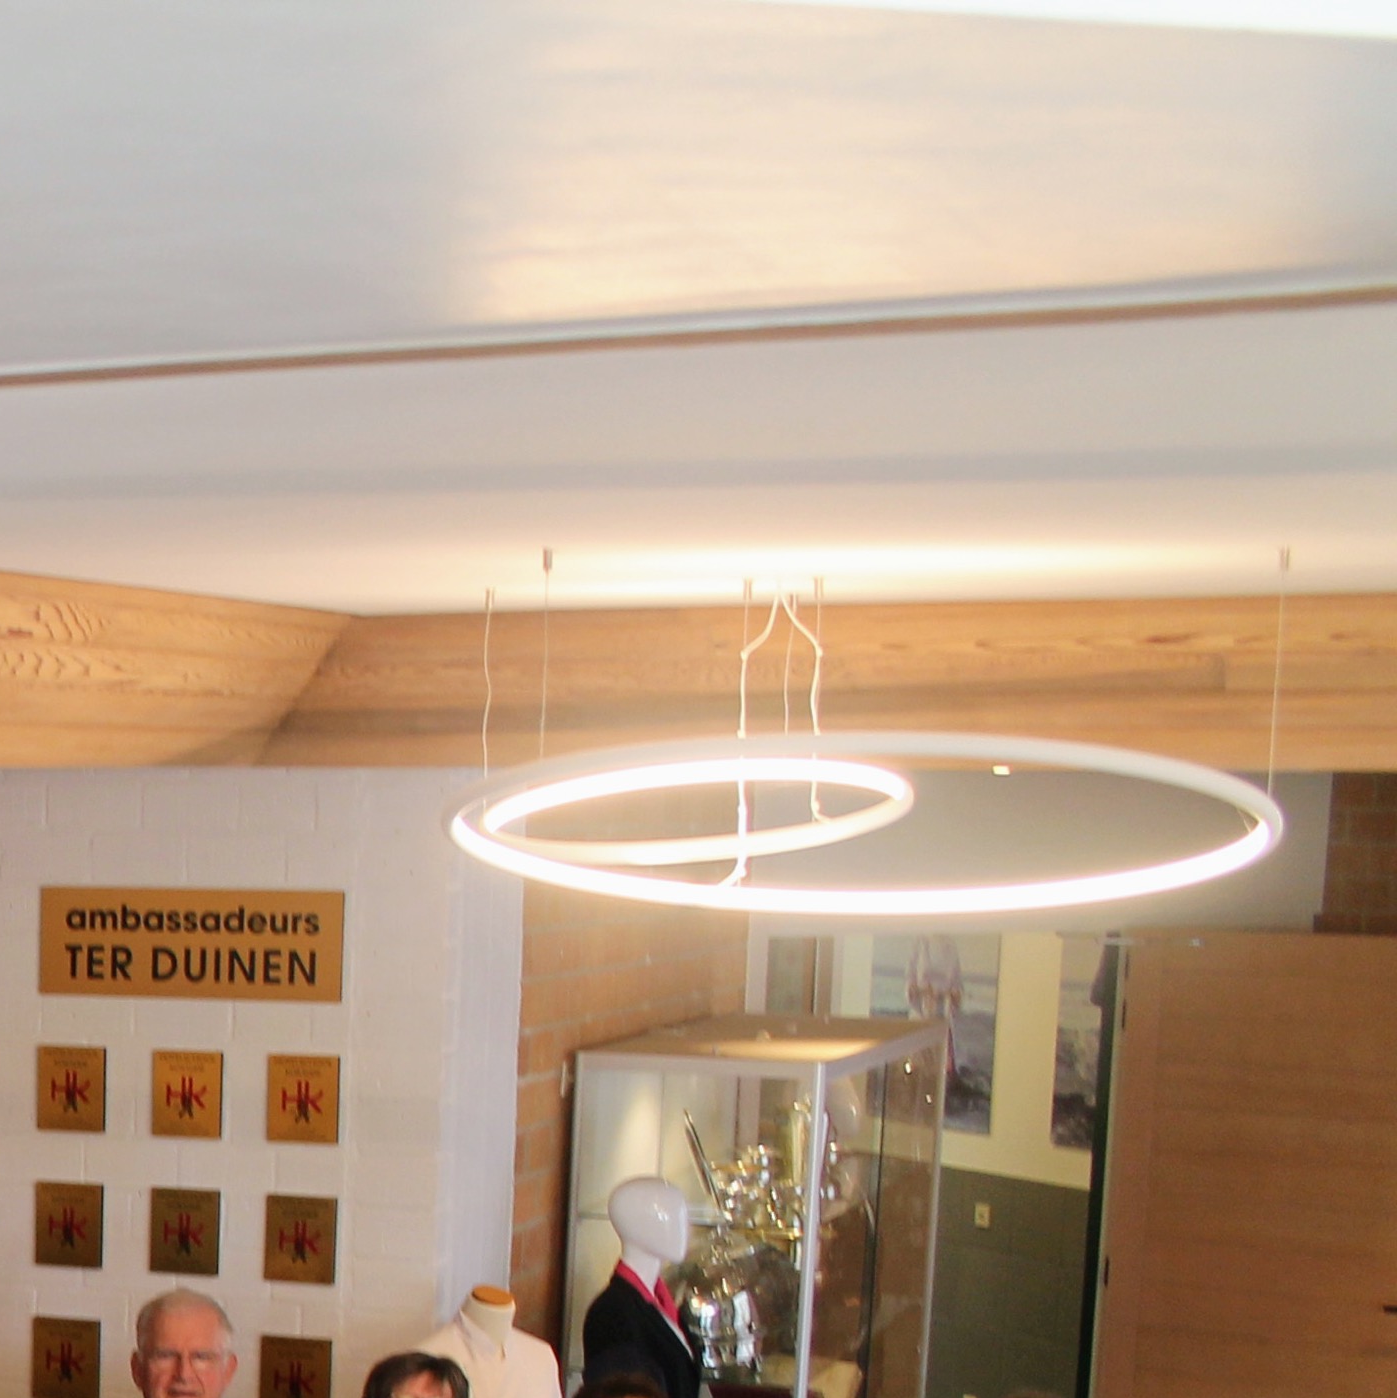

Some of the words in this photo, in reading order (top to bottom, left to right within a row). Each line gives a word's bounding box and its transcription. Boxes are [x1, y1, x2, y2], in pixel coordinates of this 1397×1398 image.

[66, 904, 319, 934] ambassadeurs
[65, 943, 133, 981] TER
[151, 946, 317, 986] DUINEN
